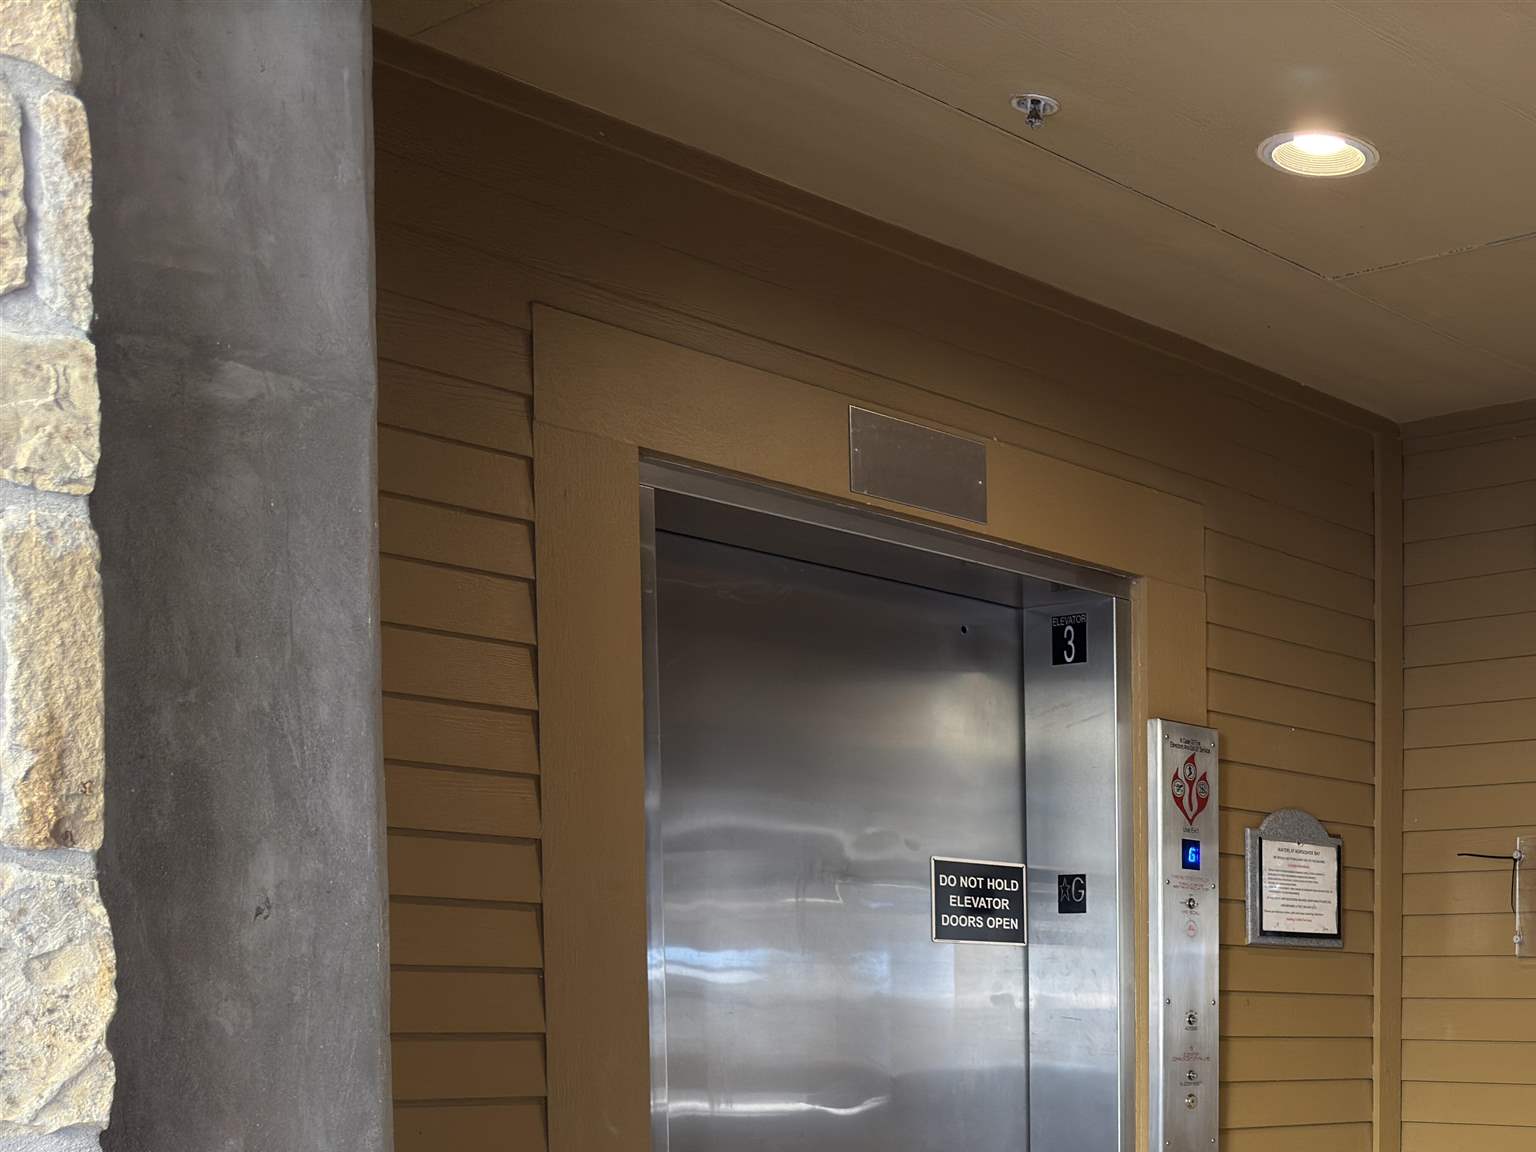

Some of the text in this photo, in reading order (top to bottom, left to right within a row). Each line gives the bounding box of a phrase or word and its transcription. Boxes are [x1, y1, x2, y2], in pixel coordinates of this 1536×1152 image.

[1052, 614, 1087, 627] ELEVATOR
[1063, 625, 1075, 663] 3
[939, 874, 1019, 892] DO NOT HOLD
[1071, 876, 1085, 903] G
[949, 894, 1010, 911] ELEVATOR
[941, 914, 1019, 930] DOORS OPEN
